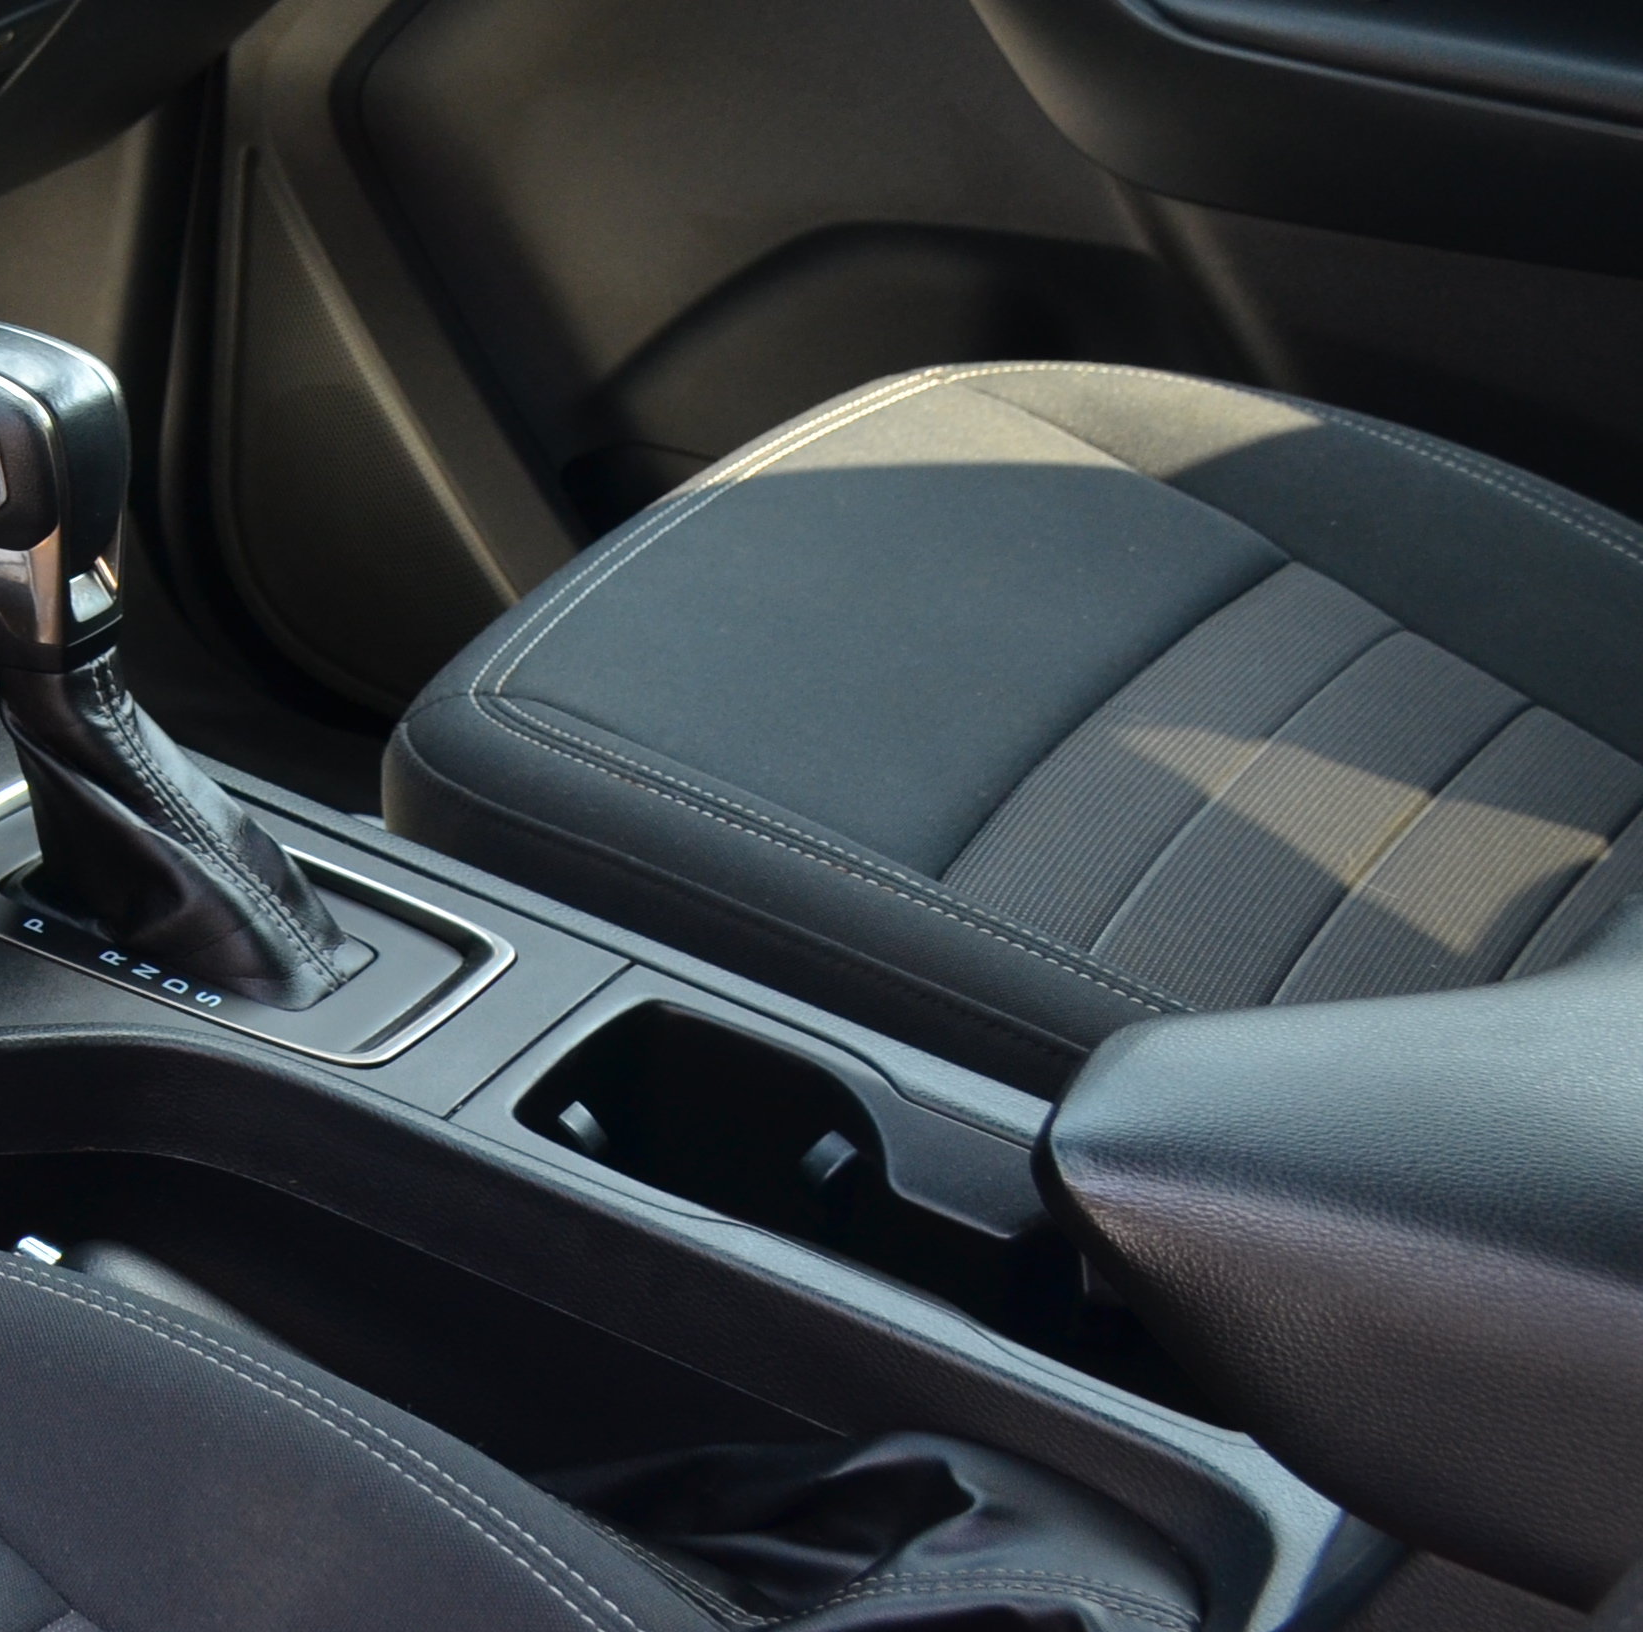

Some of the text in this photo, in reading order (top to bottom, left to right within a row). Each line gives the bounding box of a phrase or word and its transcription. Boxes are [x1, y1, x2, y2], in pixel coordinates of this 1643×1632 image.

[23, 918, 222, 1007] P R N D S
